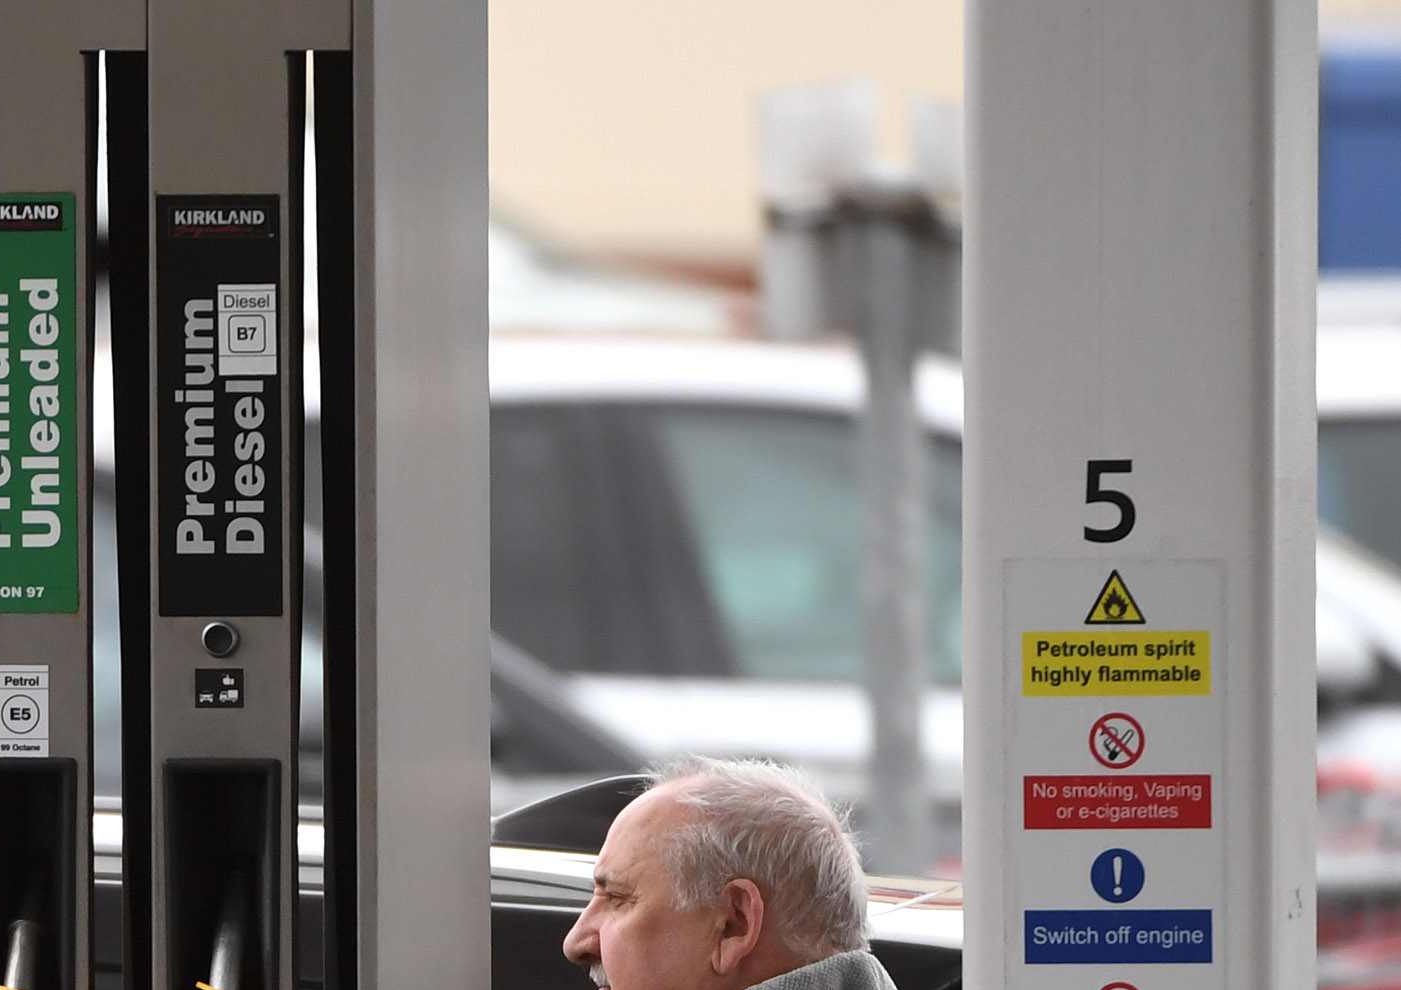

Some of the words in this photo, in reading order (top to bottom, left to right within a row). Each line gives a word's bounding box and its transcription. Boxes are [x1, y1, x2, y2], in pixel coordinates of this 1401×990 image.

[175, 210, 265, 225] KIRKLAND
[223, 294, 270, 308] Diesel
[237, 327, 257, 340] B7
[19, 278, 61, 547] Unleaded
[175, 299, 215, 554] Premium
[225, 380, 265, 554] Diesel
[1083, 459, 1136, 543] 5
[26, 586, 44, 598] 97
[1037, 641, 1138, 657] Petroleum
[1144, 640, 1195, 660] spirit
[4, 676, 39, 686] Petrol
[1031, 666, 1092, 686] highly
[1098, 666, 1201, 682] flammable
[10, 707, 31, 721] E5
[1033, 783, 1057, 798] No
[1063, 783, 1138, 801] smoking,
[1144, 783, 1202, 801] Vaping
[1056, 806, 1074, 819] or
[1078, 804, 1179, 822] e-cigarettes
[1033, 926, 1099, 945] Switch
[1105, 926, 1130, 944] off
[1136, 926, 1204, 948] engine
